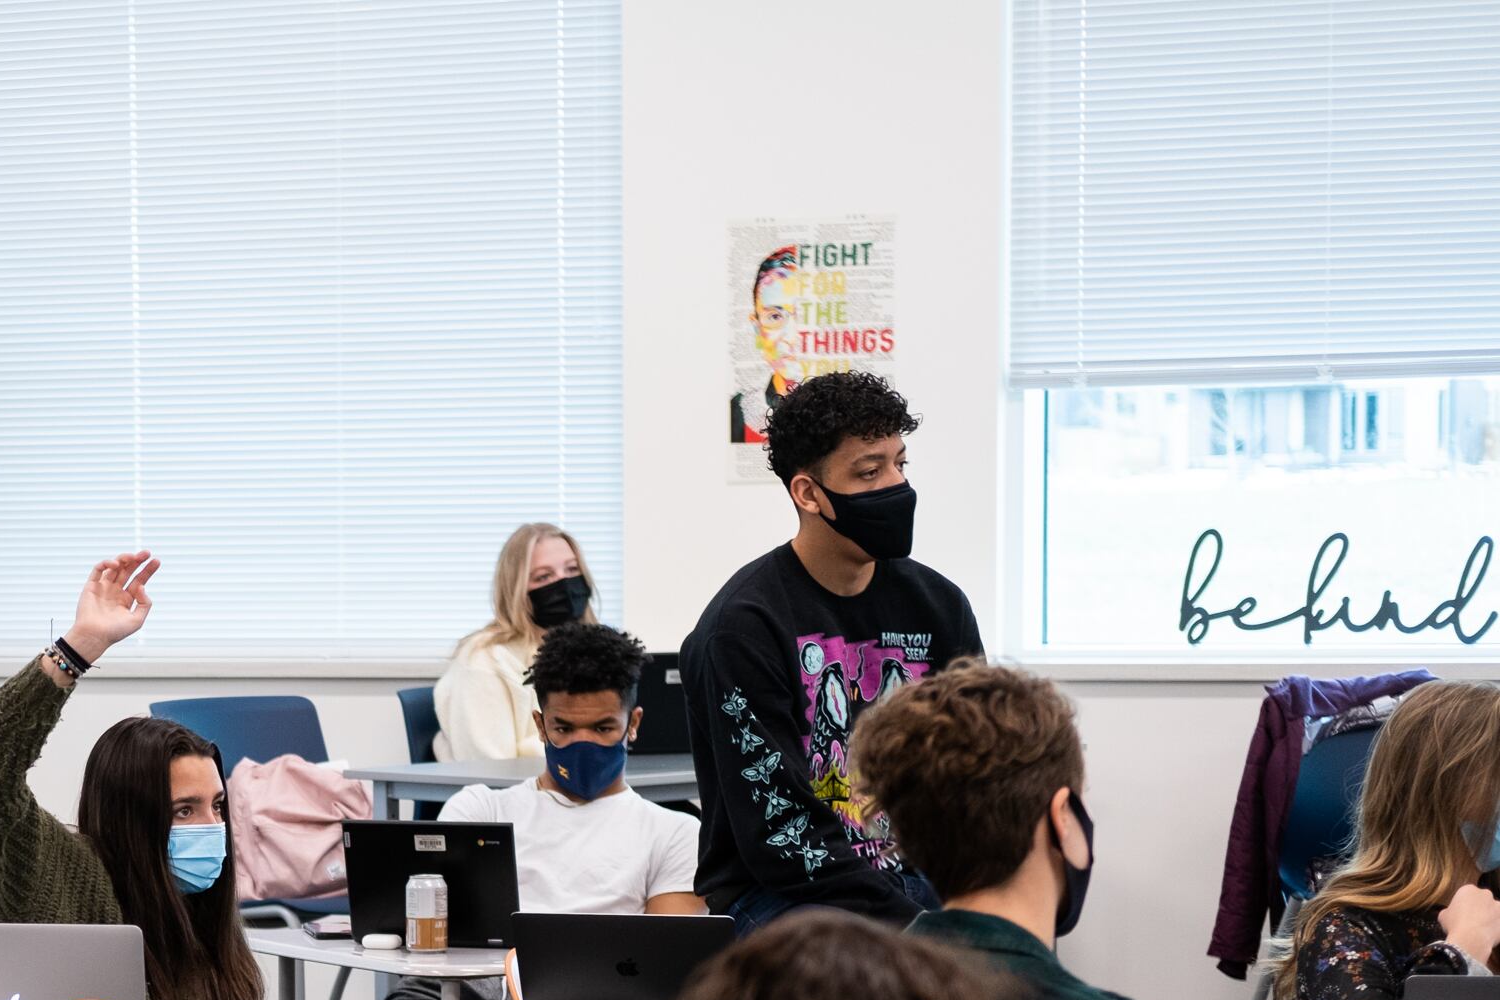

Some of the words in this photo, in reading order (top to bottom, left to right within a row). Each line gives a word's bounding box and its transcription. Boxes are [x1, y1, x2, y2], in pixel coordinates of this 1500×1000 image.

[800, 242, 873, 268] FIGHT
[800, 271, 847, 297] FOR
[801, 301, 848, 326] THE
[799, 328, 895, 353] THINGS
[881, 631, 907, 647] HAVE
[906, 633, 932, 648] YOU
